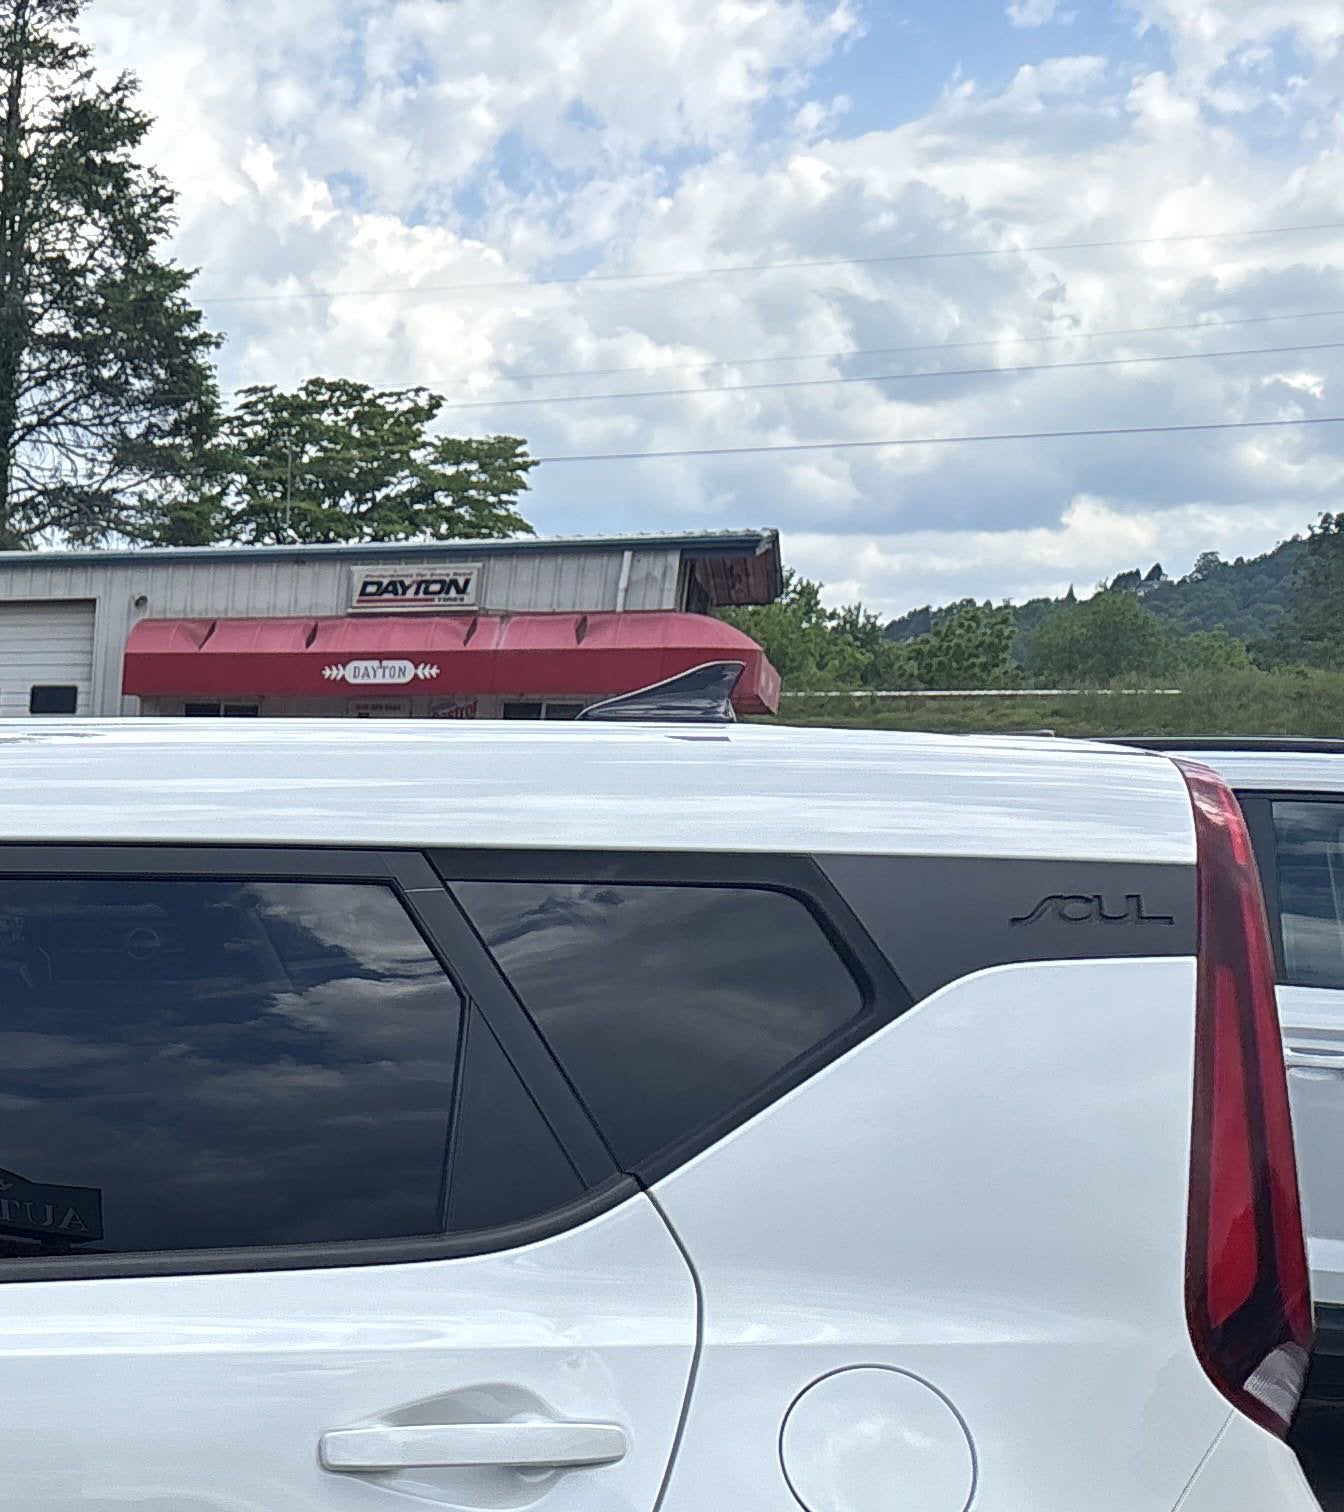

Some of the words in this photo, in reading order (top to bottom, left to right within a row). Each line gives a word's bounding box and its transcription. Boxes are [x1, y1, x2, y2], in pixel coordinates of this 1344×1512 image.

[359, 578, 471, 596] DAYTON
[353, 665, 407, 679] DAYTON
[1009, 894, 1175, 925] SOUL
